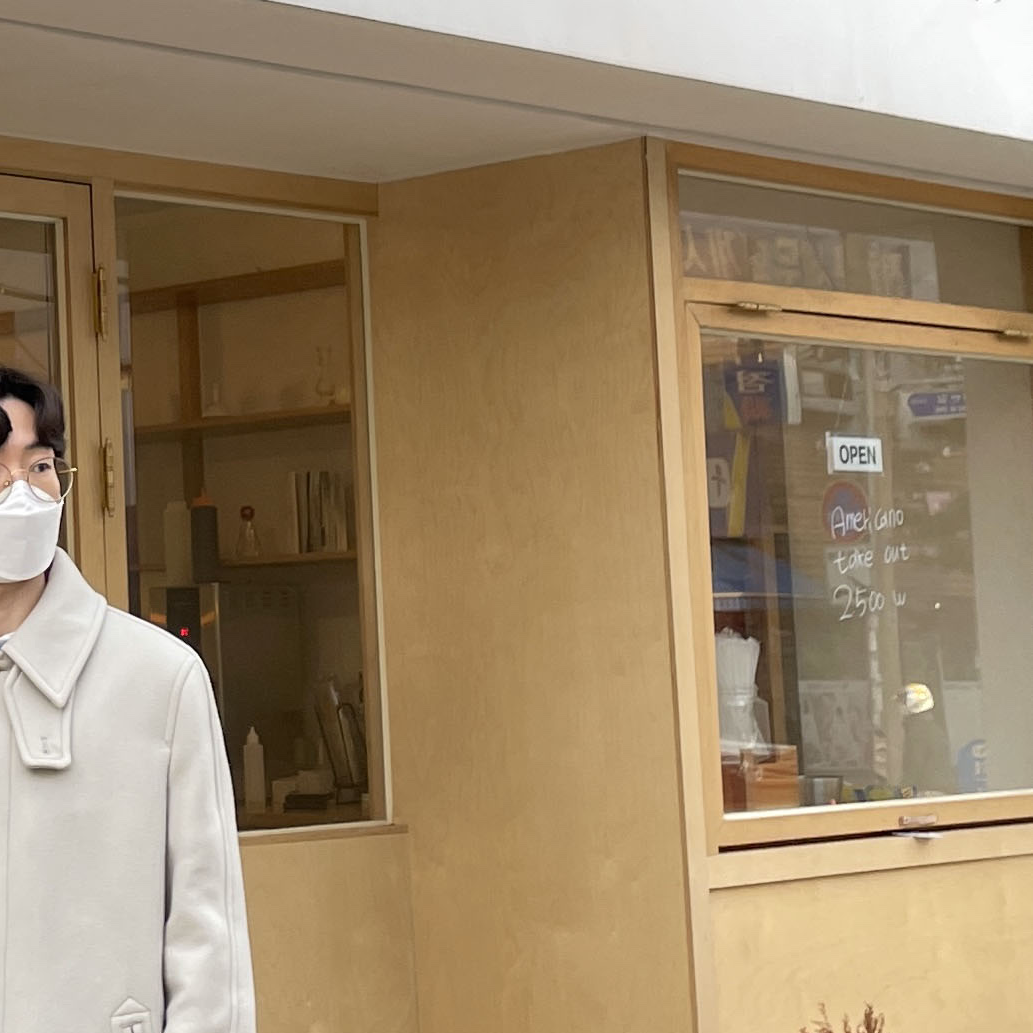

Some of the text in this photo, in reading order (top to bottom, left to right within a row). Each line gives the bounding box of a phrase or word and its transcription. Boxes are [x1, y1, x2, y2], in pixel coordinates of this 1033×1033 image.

[839, 445, 877, 465] OPEN
[830, 505, 905, 539] Americano
[833, 542, 910, 575] take out
[833, 583, 885, 621] 2500
